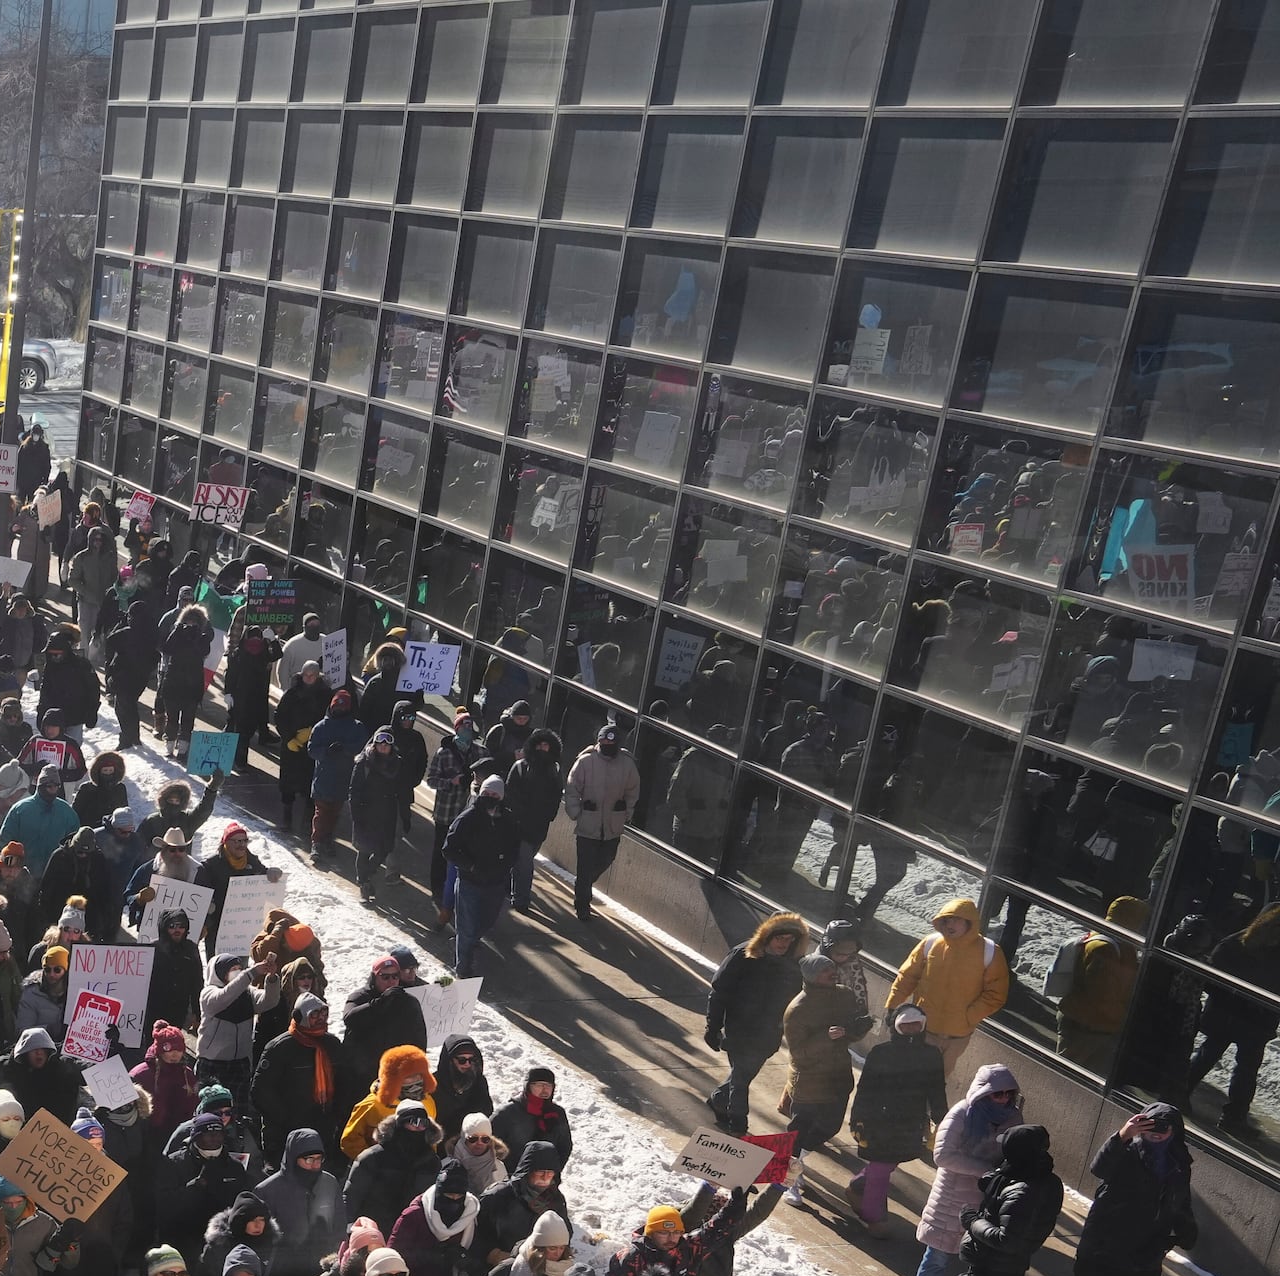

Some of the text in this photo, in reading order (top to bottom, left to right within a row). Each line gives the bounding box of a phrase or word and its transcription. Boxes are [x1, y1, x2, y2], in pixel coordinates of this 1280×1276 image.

[194, 484, 251, 507] RESIST
[188, 505, 224, 523] ICE
[251, 589, 295, 597] THE POWER
[247, 613, 294, 624] NUMBERS
[410, 645, 443, 671] This
[696, 1133, 747, 1161] Families
[681, 1154, 726, 1179] Together
